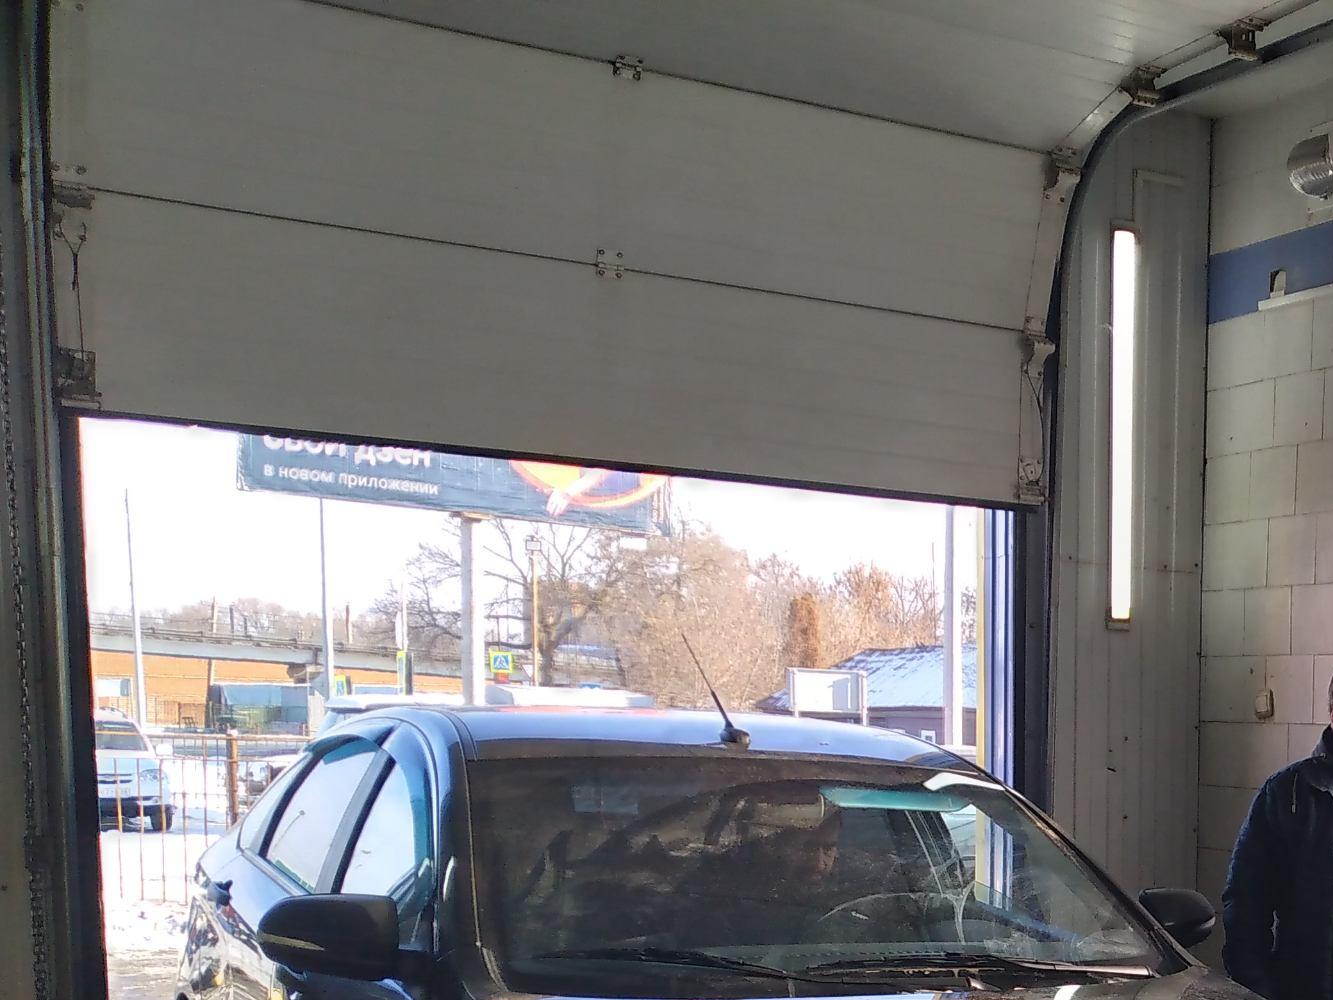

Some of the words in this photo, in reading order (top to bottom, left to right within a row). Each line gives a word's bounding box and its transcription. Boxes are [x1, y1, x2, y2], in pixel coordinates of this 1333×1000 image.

[263, 464, 274, 477] в
[279, 467, 333, 483] новом
[339, 473, 440, 495] приложении
